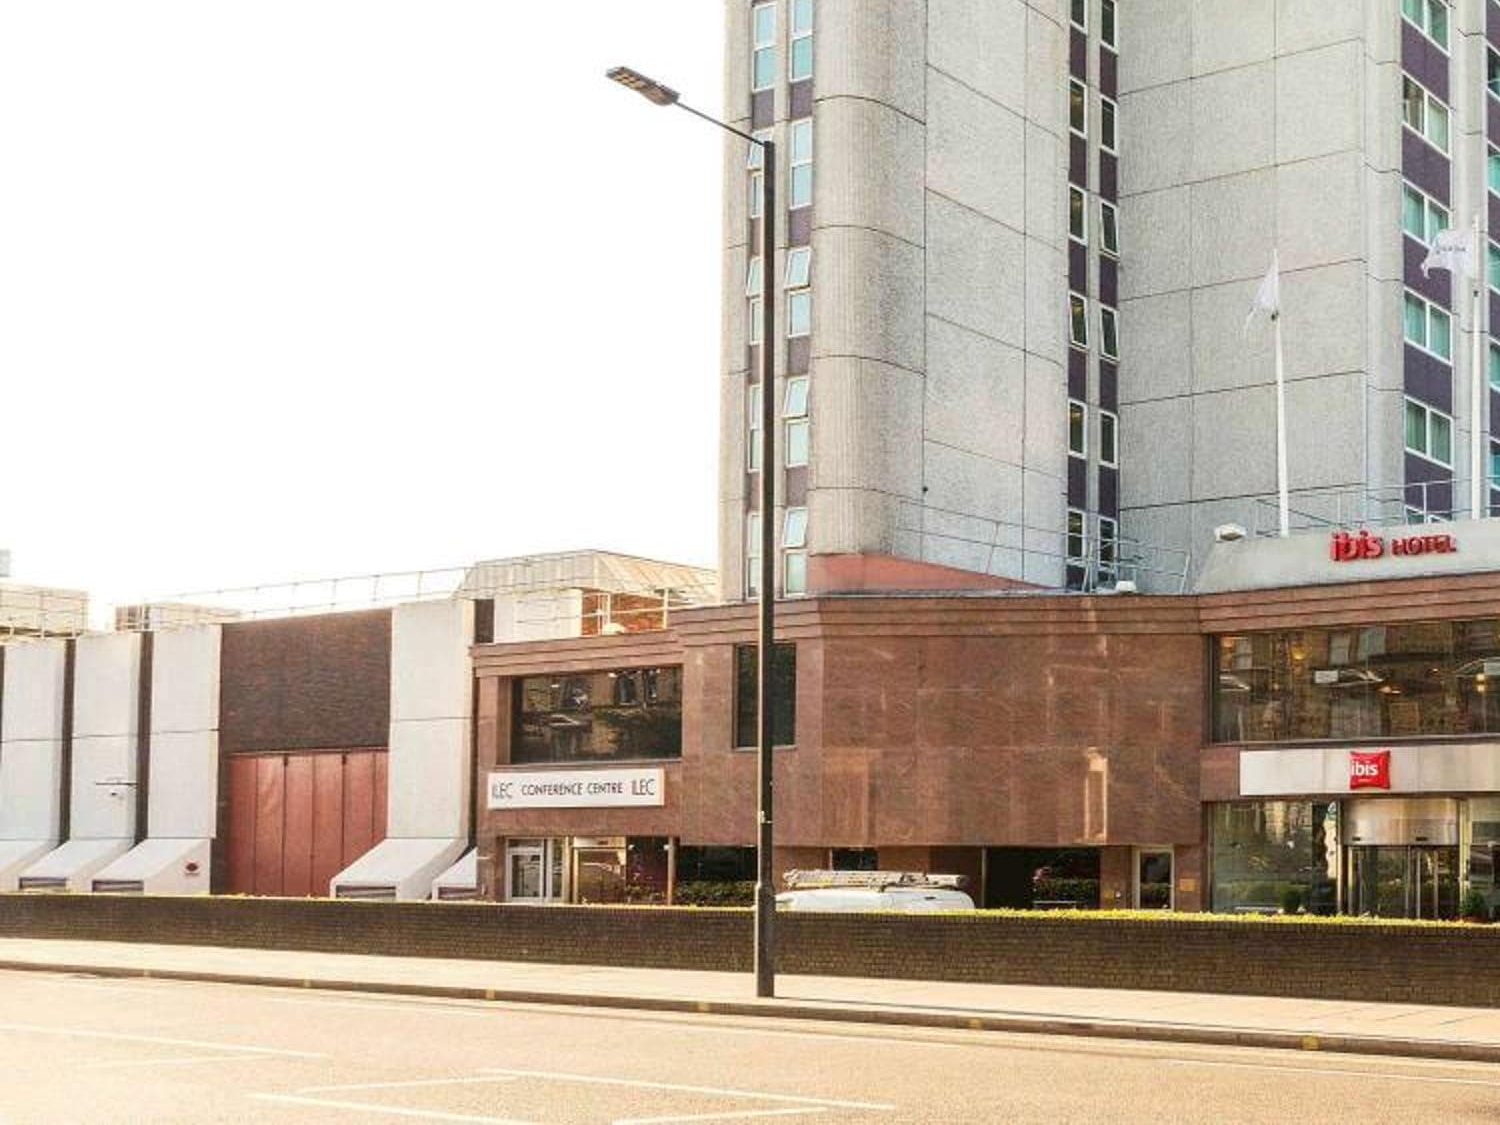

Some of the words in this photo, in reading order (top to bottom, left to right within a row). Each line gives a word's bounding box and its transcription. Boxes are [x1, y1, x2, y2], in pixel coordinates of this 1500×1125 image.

[1329, 530, 1384, 561] ibis
[1391, 535, 1457, 555] HOTEL
[1351, 760, 1379, 776] ibis
[521, 782, 583, 796] CONFERENCE
[586, 781, 624, 795] CENTRE
